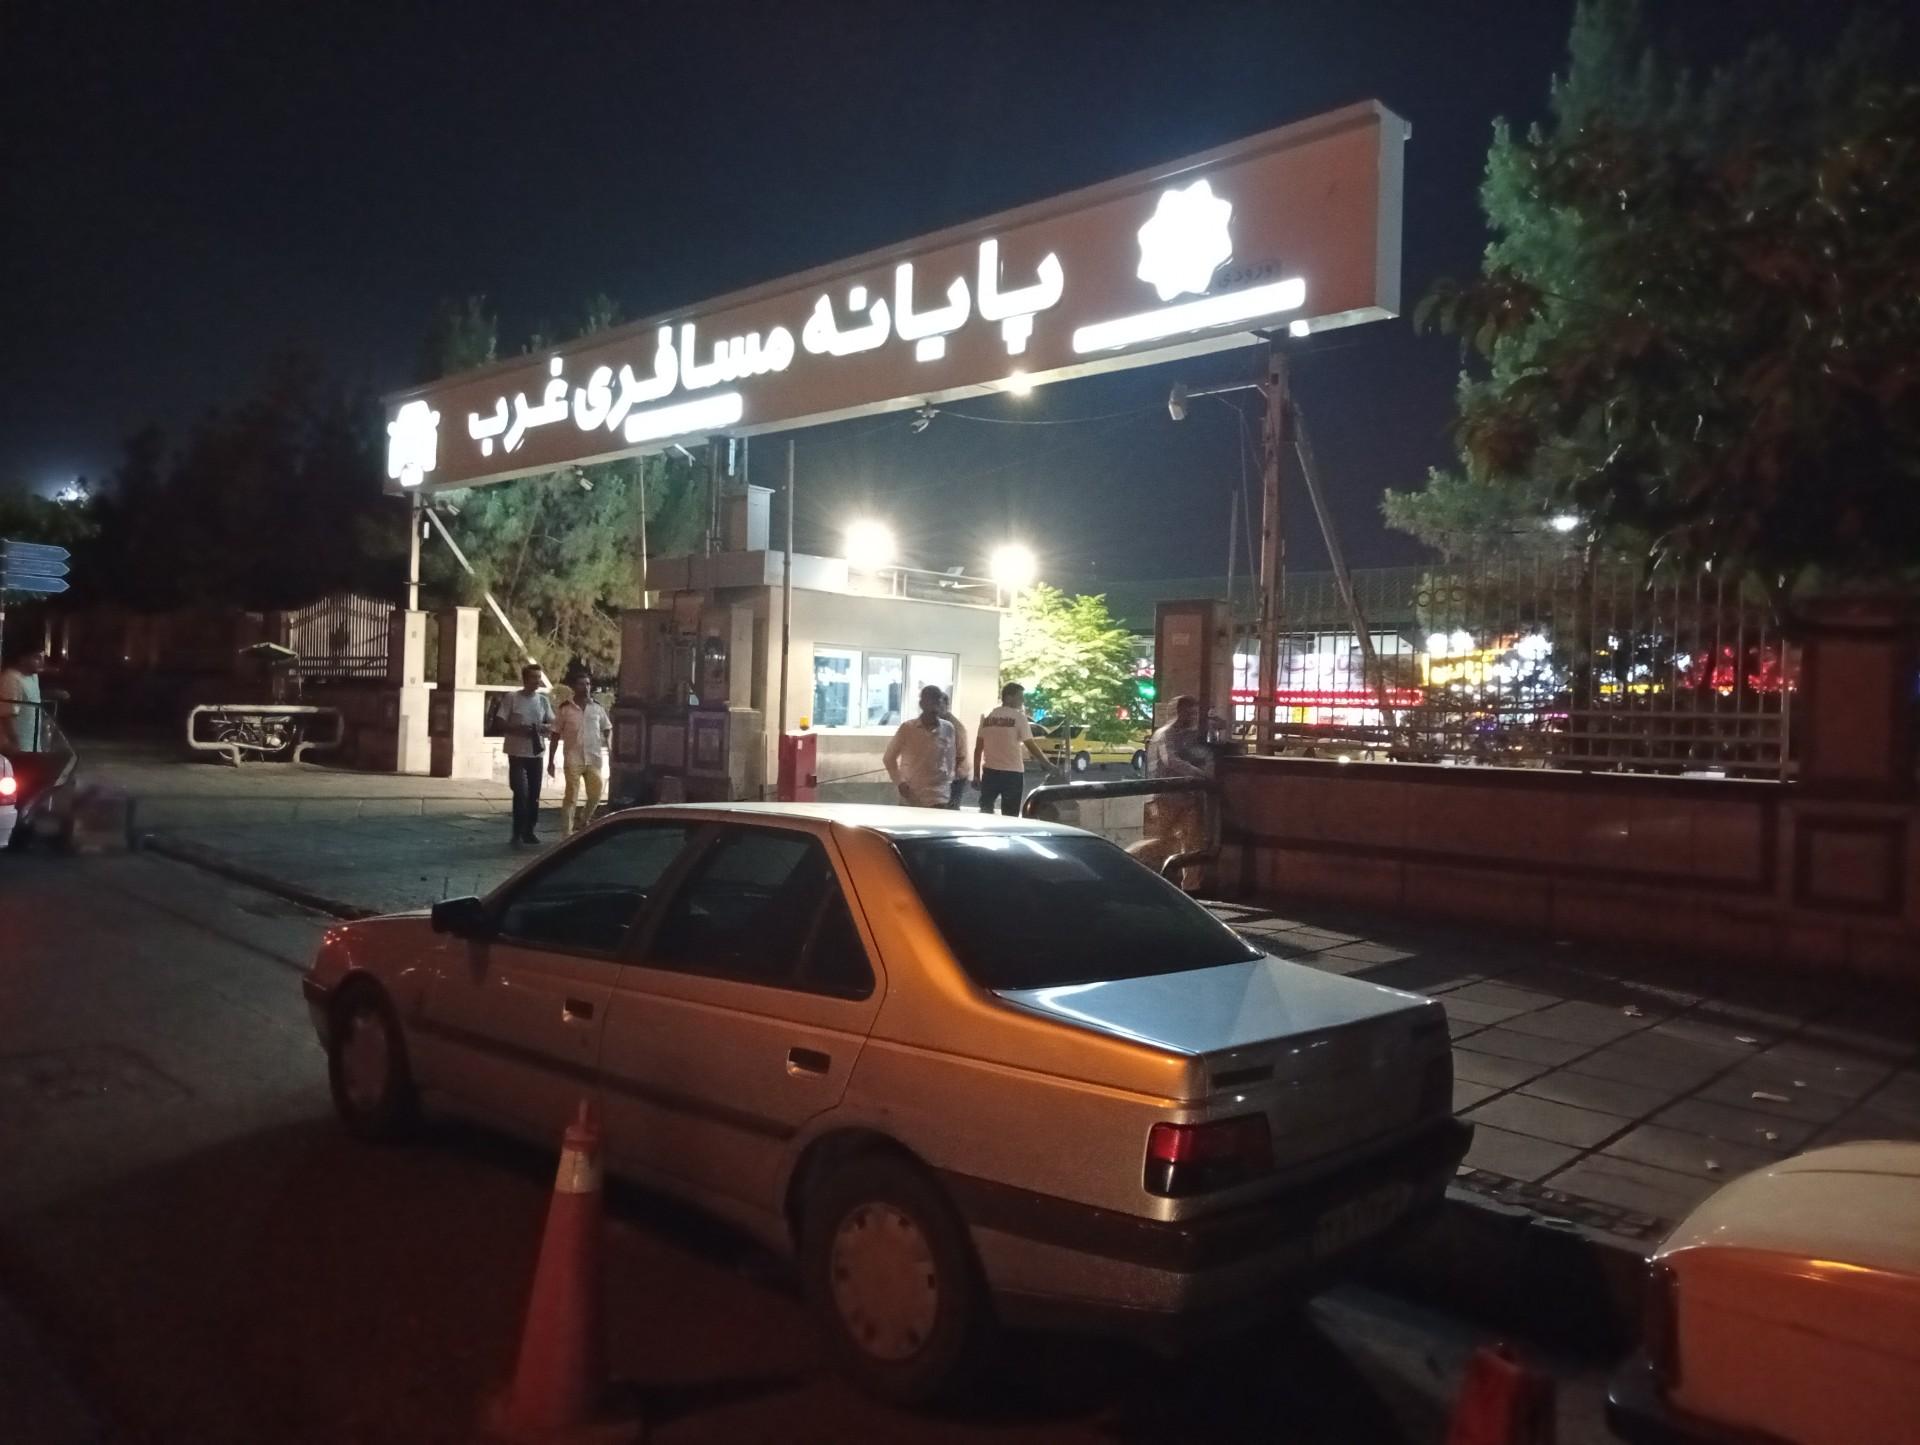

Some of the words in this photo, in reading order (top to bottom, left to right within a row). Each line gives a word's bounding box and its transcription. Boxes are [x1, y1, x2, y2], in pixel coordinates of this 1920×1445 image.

[802, 239, 1064, 362] پایانه
[469, 357, 568, 456] غرب
[574, 323, 794, 431] مسافری
